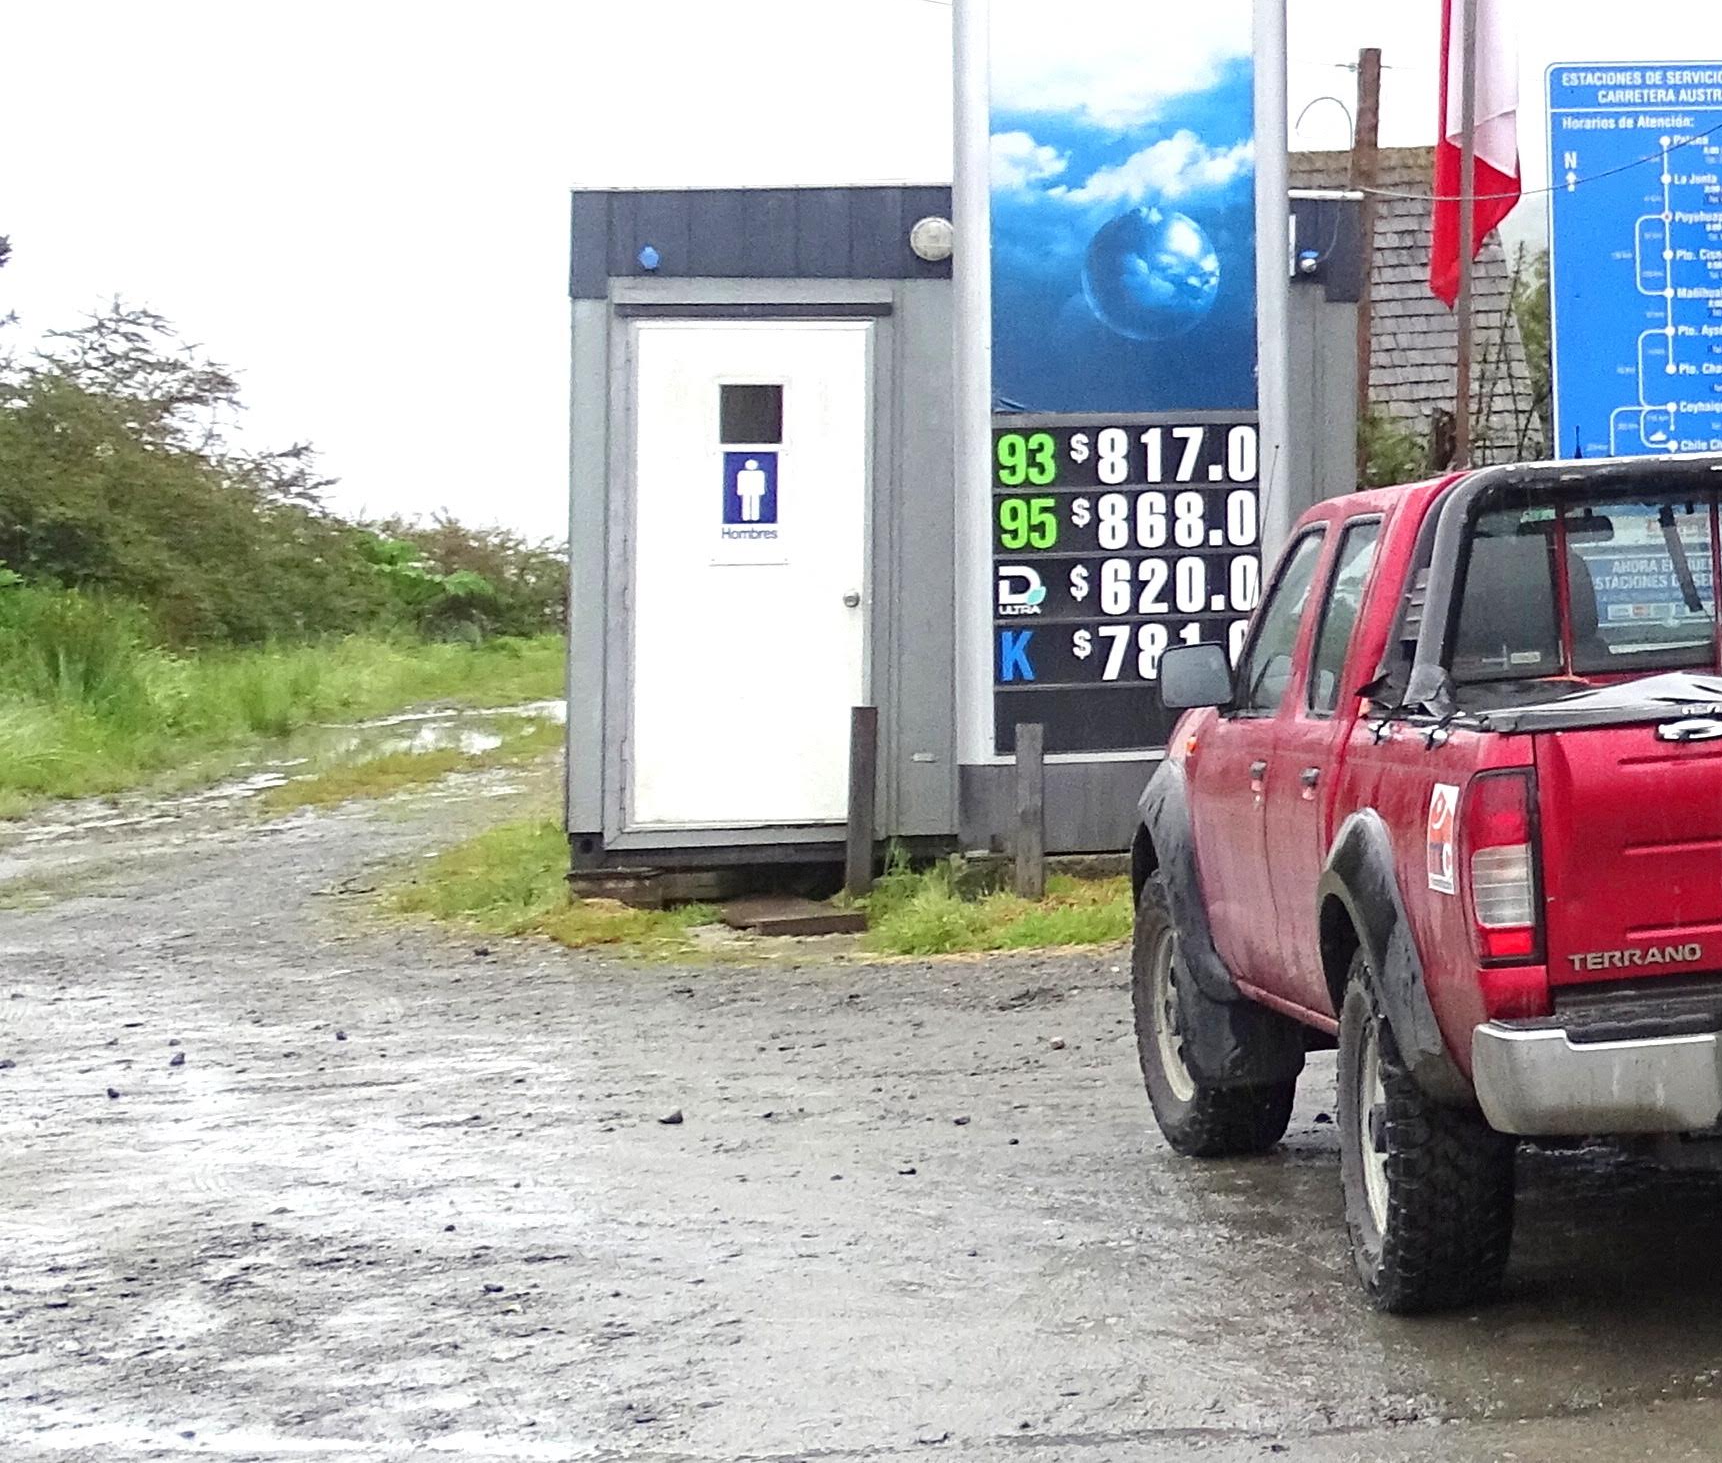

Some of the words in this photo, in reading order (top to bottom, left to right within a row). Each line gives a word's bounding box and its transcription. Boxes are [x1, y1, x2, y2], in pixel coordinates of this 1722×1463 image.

[1562, 72, 1642, 86] ESTACIONES
[1645, 71, 1663, 85] DE
[1598, 89, 1675, 103] CARRETERA
[1562, 115, 1616, 129] Horarios
[1618, 116, 1634, 128] de
[1564, 152, 1577, 169] N
[997, 433, 1056, 485] 93
[999, 497, 1058, 549] 95
[722, 527, 778, 539] Hombres
[1613, 559, 1658, 573] AHORA
[999, 605, 1041, 615] ULTRA
[1001, 631, 1036, 682] K
[1569, 944, 1701, 971] TERRANO
